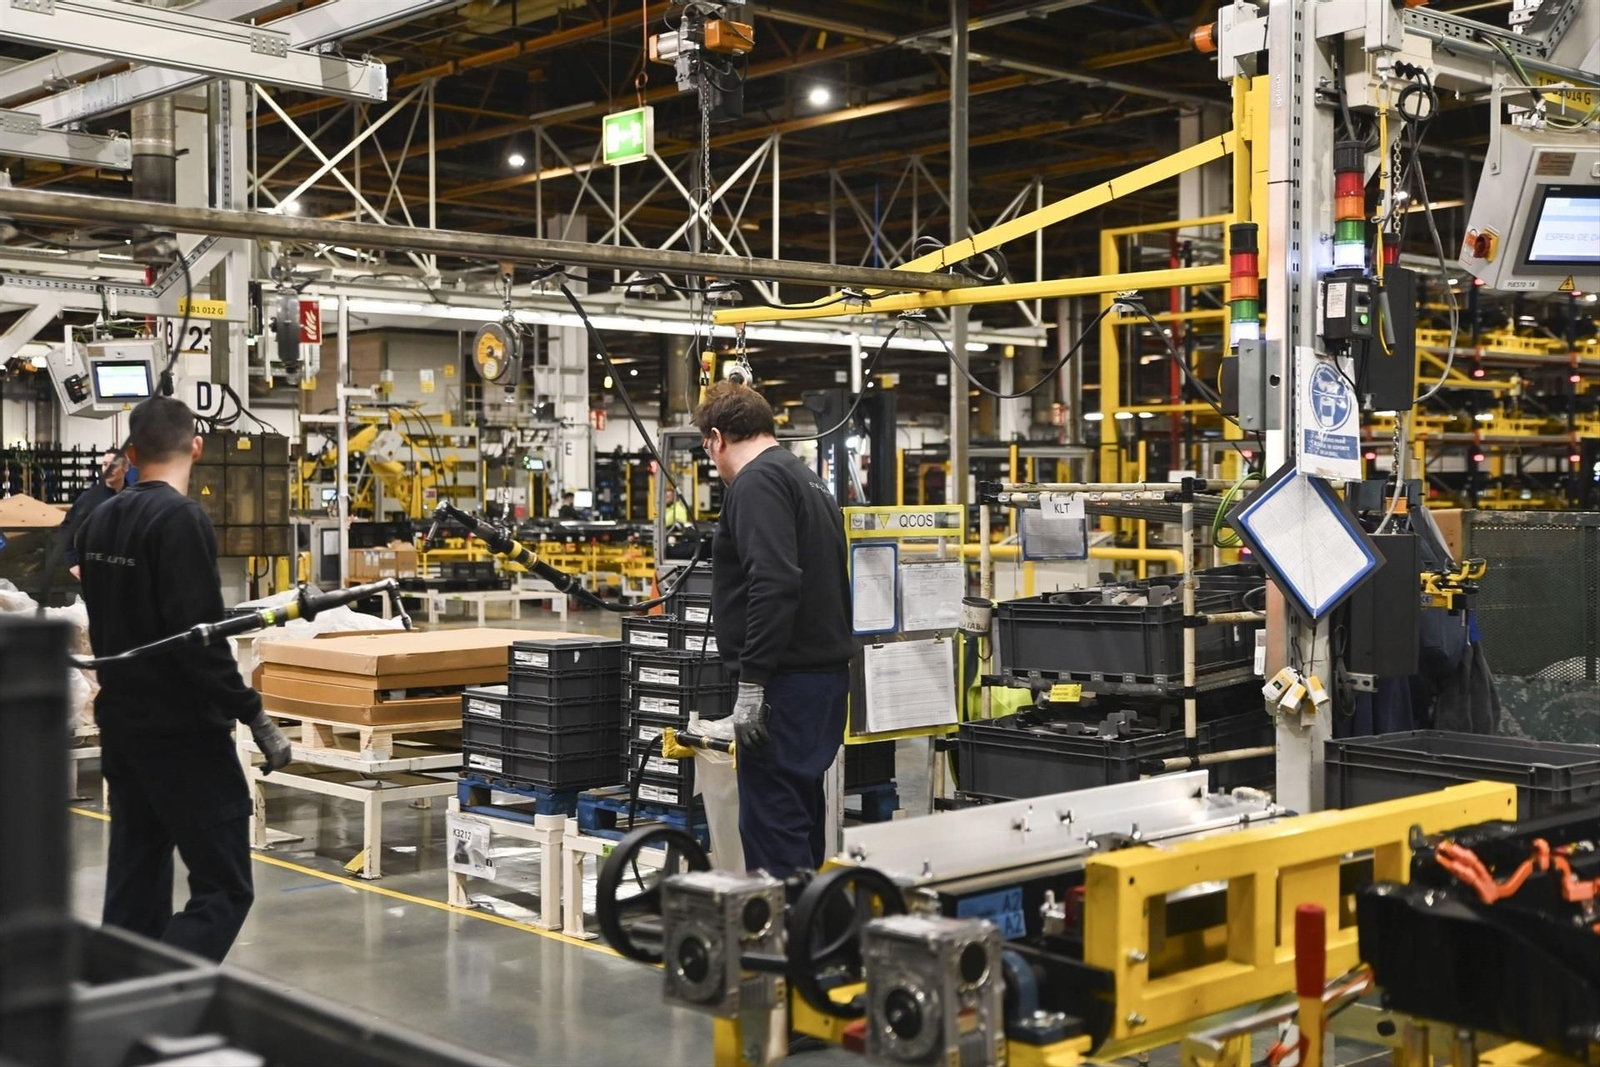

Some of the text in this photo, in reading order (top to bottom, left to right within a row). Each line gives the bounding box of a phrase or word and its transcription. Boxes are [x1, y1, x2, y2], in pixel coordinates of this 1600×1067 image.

[1584, 92, 1591, 106] G
[197, 381, 212, 411] D
[565, 442, 573, 456] E
[1054, 503, 1070, 513] KLT
[899, 514, 934, 528] QCOS
[453, 828, 472, 840] K3212
[1002, 891, 1021, 914] A2
[1005, 913, 1022, 935] A2
